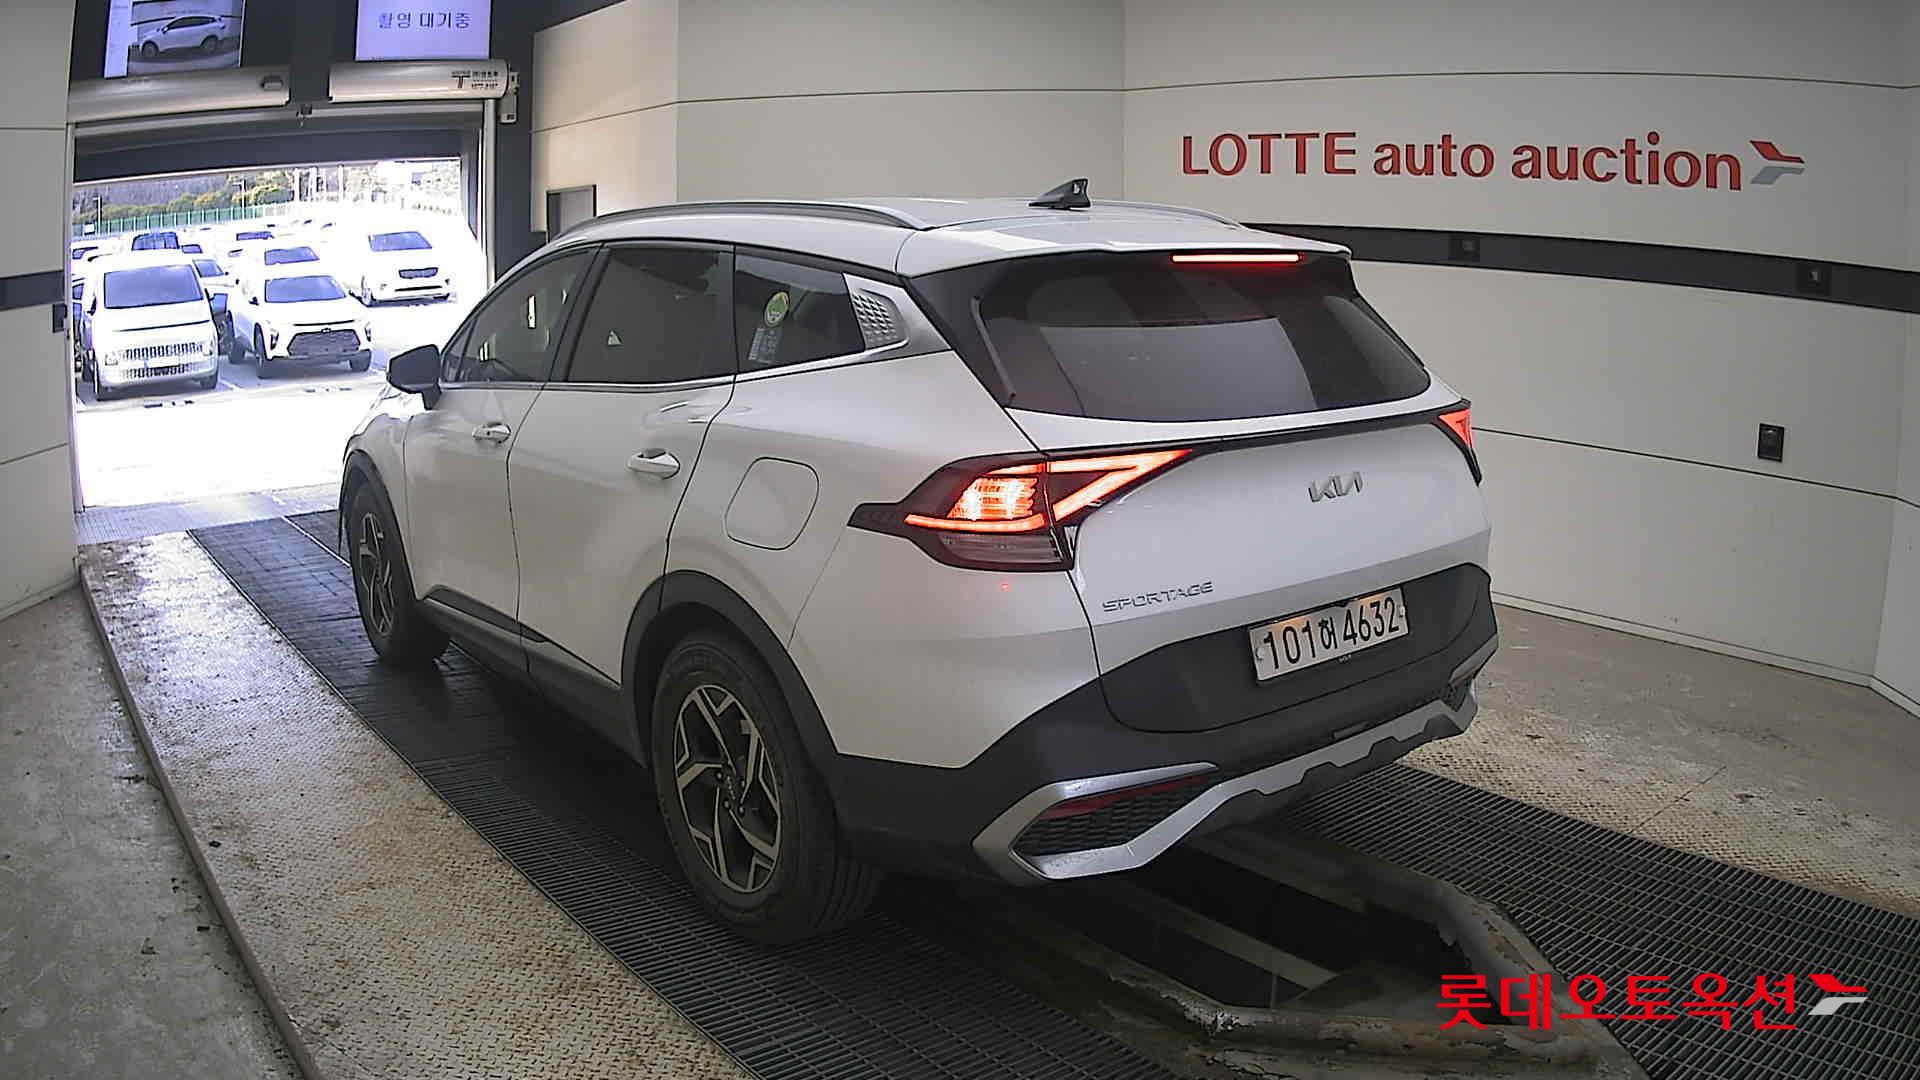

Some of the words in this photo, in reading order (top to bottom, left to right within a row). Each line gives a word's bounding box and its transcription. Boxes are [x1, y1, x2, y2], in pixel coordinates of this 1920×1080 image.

[420, 12, 471, 29] 대기중
[1182, 132, 1357, 175] LOTTE
[1373, 134, 1494, 177] auto
[1512, 131, 1741, 191] auction
[1102, 581, 1213, 612] SPORTAGE
